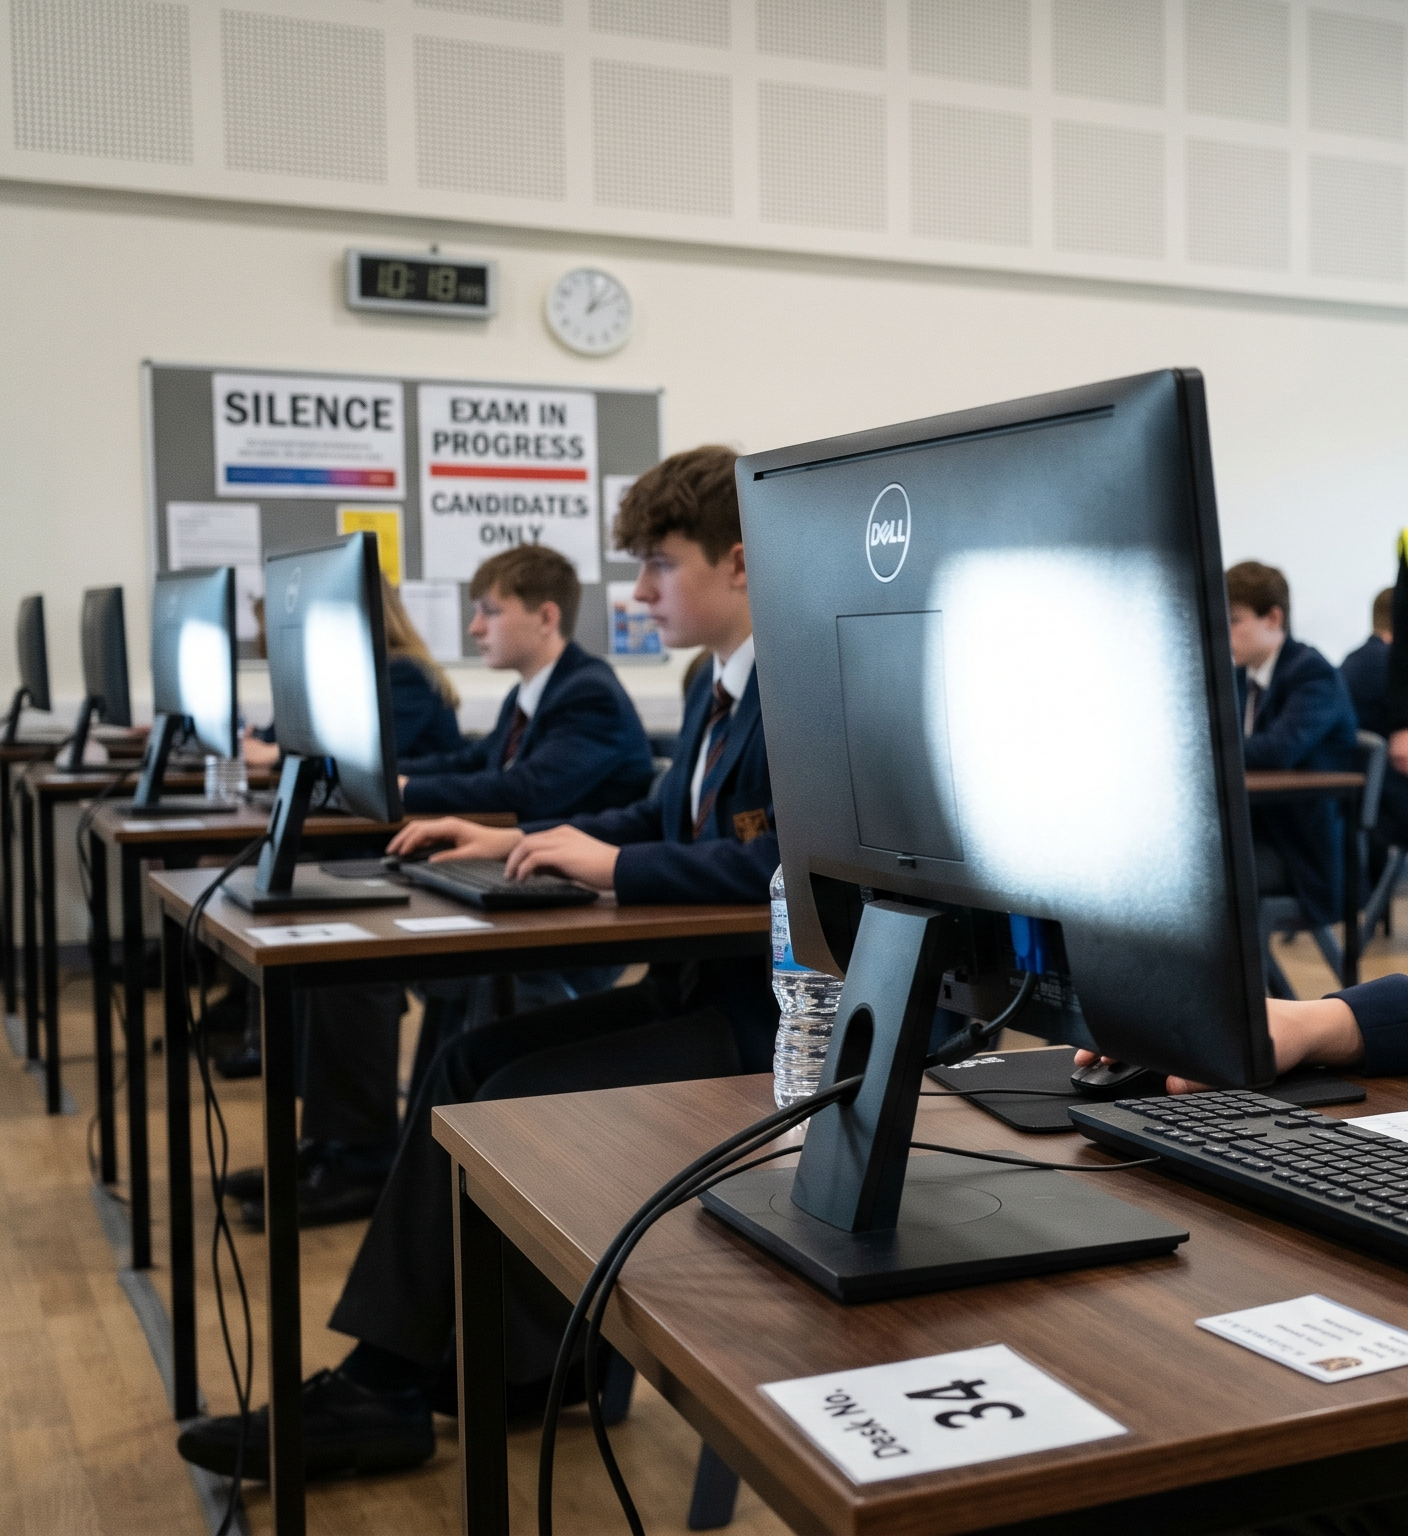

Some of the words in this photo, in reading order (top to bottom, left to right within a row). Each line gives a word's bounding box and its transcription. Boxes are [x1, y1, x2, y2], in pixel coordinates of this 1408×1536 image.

[376, 261, 458, 301] 10:18
[225, 390, 394, 432] SILENCE
[450, 398, 529, 425] EXAM
[539, 402, 566, 427] IN
[432, 430, 584, 460] PROGRESS
[431, 492, 589, 519] CANDIDATES
[479, 522, 543, 546] ONLY
[870, 519, 906, 547] DELL
[823, 1388, 866, 1418] No.
[904, 1378, 1026, 1429] 34
[843, 1417, 910, 1459] Desk
